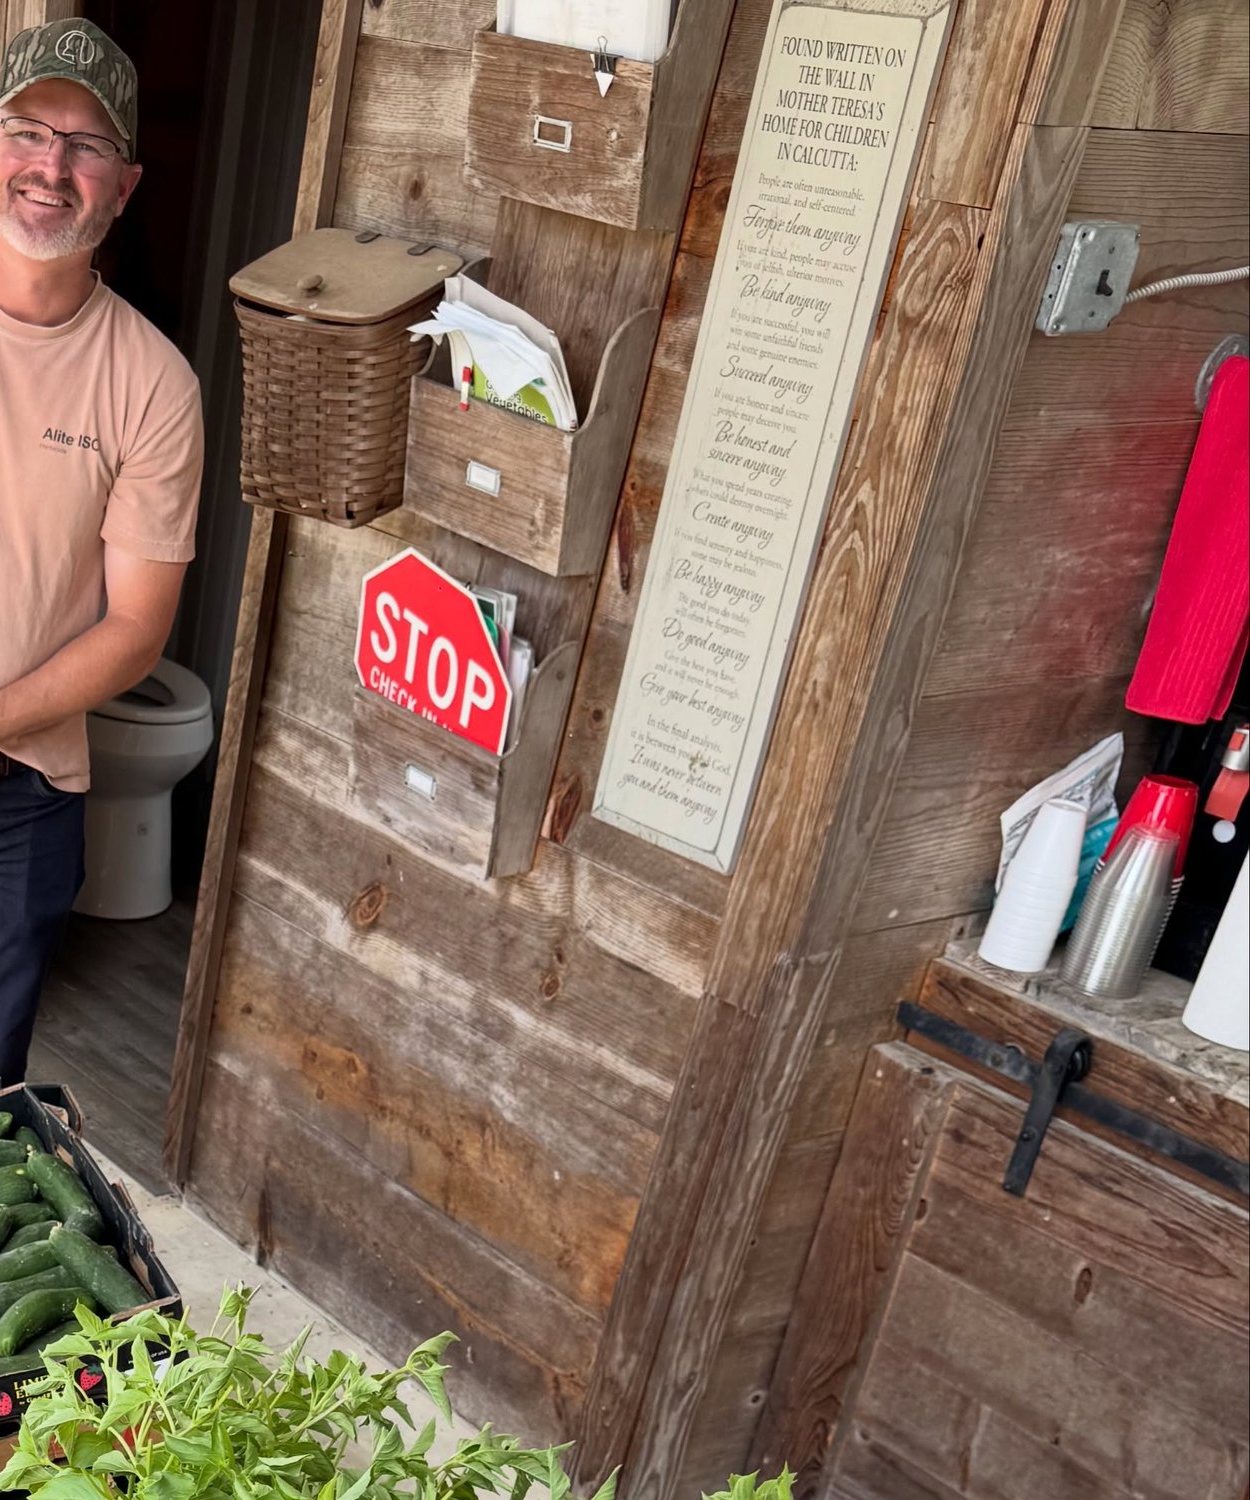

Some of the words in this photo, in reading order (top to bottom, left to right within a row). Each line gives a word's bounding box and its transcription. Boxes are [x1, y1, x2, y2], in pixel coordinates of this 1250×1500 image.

[780, 36, 823, 58] FOUND
[826, 41, 884, 65] WRITTEN
[884, 47, 907, 68] ON
[799, 65, 823, 86] THE
[825, 68, 856, 91] WALL
[858, 71, 876, 92] IN
[776, 89, 828, 114] MOTHER
[831, 96, 886, 121] TERESA'S
[761, 113, 798, 136] HOME
[798, 119, 823, 139] FOR
[824, 122, 890, 149] CHILDREN
[777, 142, 792, 161] IN
[792, 144, 859, 172] CALCUTTA:
[758, 172, 781, 189] People
[781, 180, 793, 189] are
[794, 179, 813, 193] often
[793, 197, 807, 208] and
[743, 204, 786, 240] Forgive
[785, 212, 811, 238] them
[813, 227, 861, 256] anyway
[789, 252, 814, 267] people
[740, 274, 760, 299] Be
[761, 278, 791, 303] kind
[785, 293, 832, 323] anyway
[737, 313, 751, 323] you
[800, 327, 815, 337] you
[719, 354, 774, 385] Succeed
[768, 375, 814, 404] anyway
[770, 403, 786, 415] and
[42, 427, 75, 446] Alite
[715, 420, 735, 443] Be
[734, 425, 769, 452] honest
[768, 439, 798, 459] and
[707, 448, 743, 466] sincere
[742, 458, 787, 488] anyway
[692, 500, 731, 529] Create
[731, 521, 774, 550] anyway
[673, 558, 693, 580] Be
[692, 564, 723, 599] happy
[722, 582, 767, 613] anyway
[370, 591, 495, 729] STOP
[662, 617, 684, 641] Do
[677, 632, 714, 652] good
[709, 642, 750, 672] anyway
[370, 665, 417, 712] CHECK
[639, 671, 666, 698] Give
[660, 689, 688, 706] your
[687, 688, 708, 711] best
[706, 704, 746, 733] anyway
[657, 719, 670, 733] the
[670, 723, 690, 741] final
[629, 743, 646, 764] It
[642, 756, 662, 773] was
[661, 764, 687, 780] never
[616, 773, 639, 789] you
[638, 777, 663, 794] and
[657, 780, 680, 804] them
[679, 796, 718, 825] anyway
